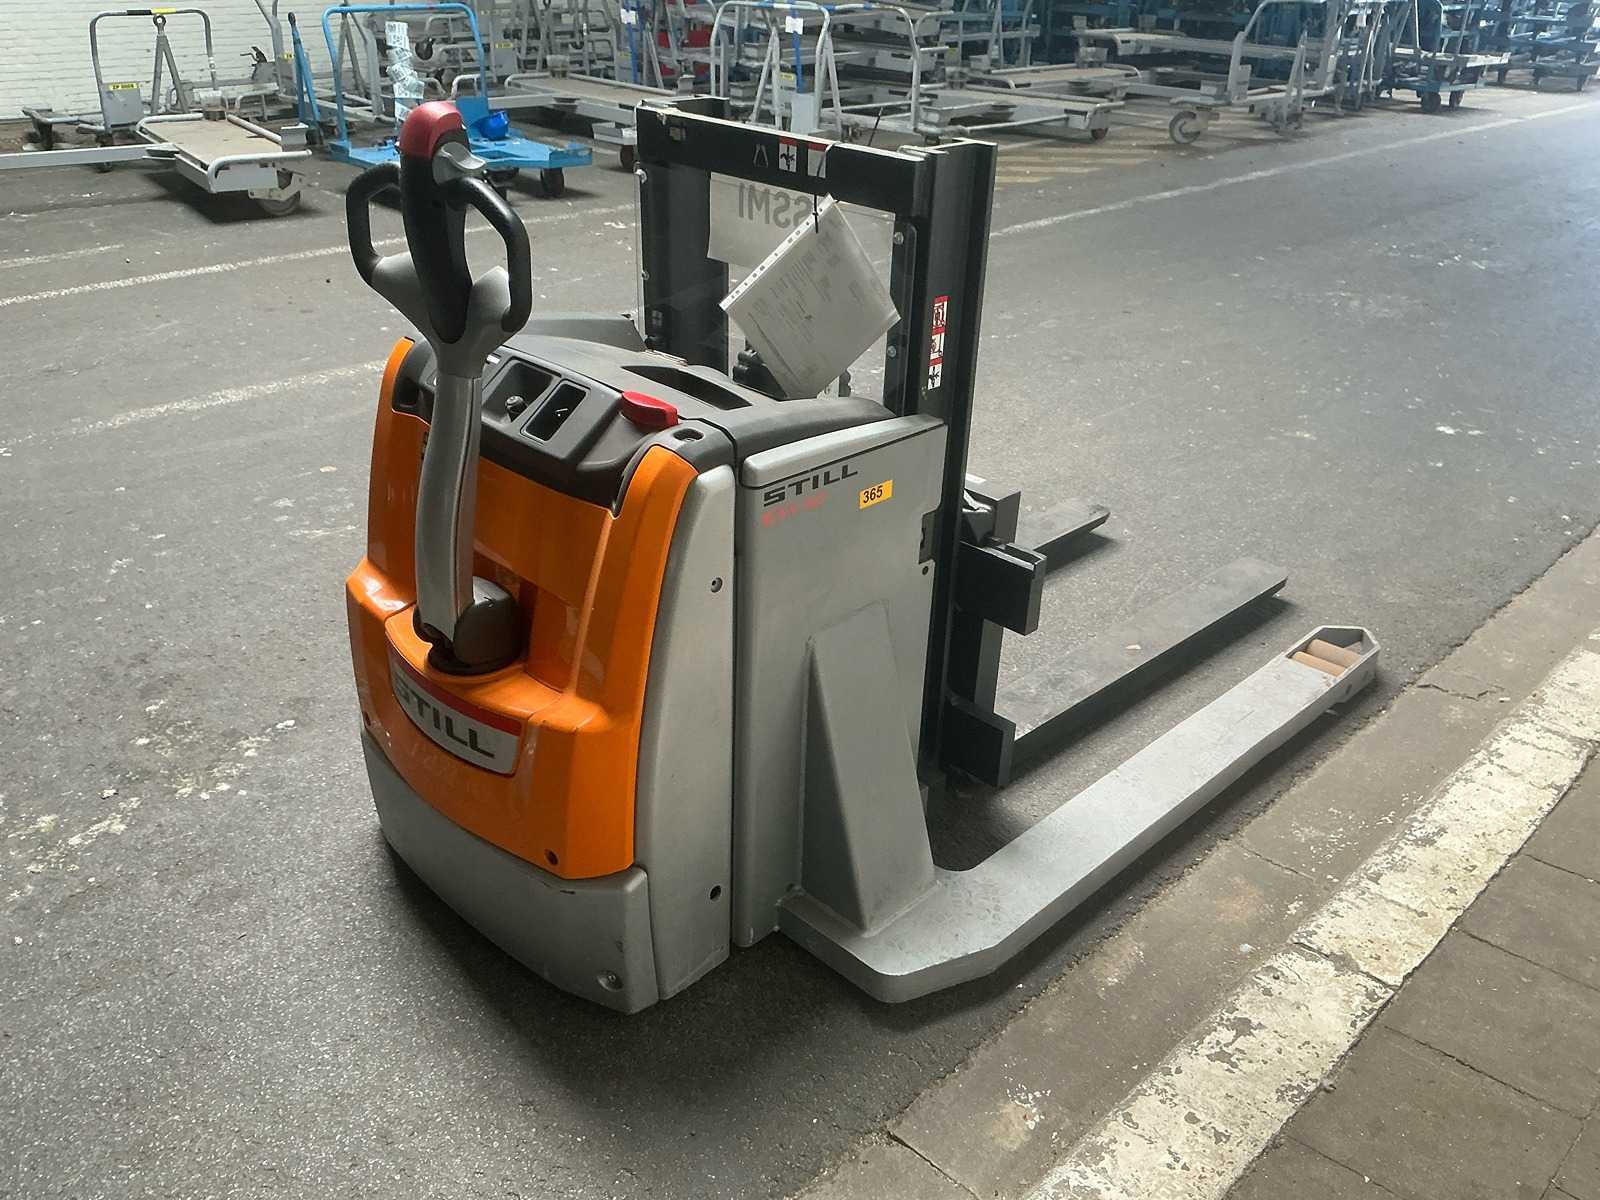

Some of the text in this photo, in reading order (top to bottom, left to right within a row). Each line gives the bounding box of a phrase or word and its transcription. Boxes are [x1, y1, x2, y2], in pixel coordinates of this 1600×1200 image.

[763, 464, 858, 507] STILL
[863, 485, 883, 504] 365
[394, 671, 497, 759] STILL
